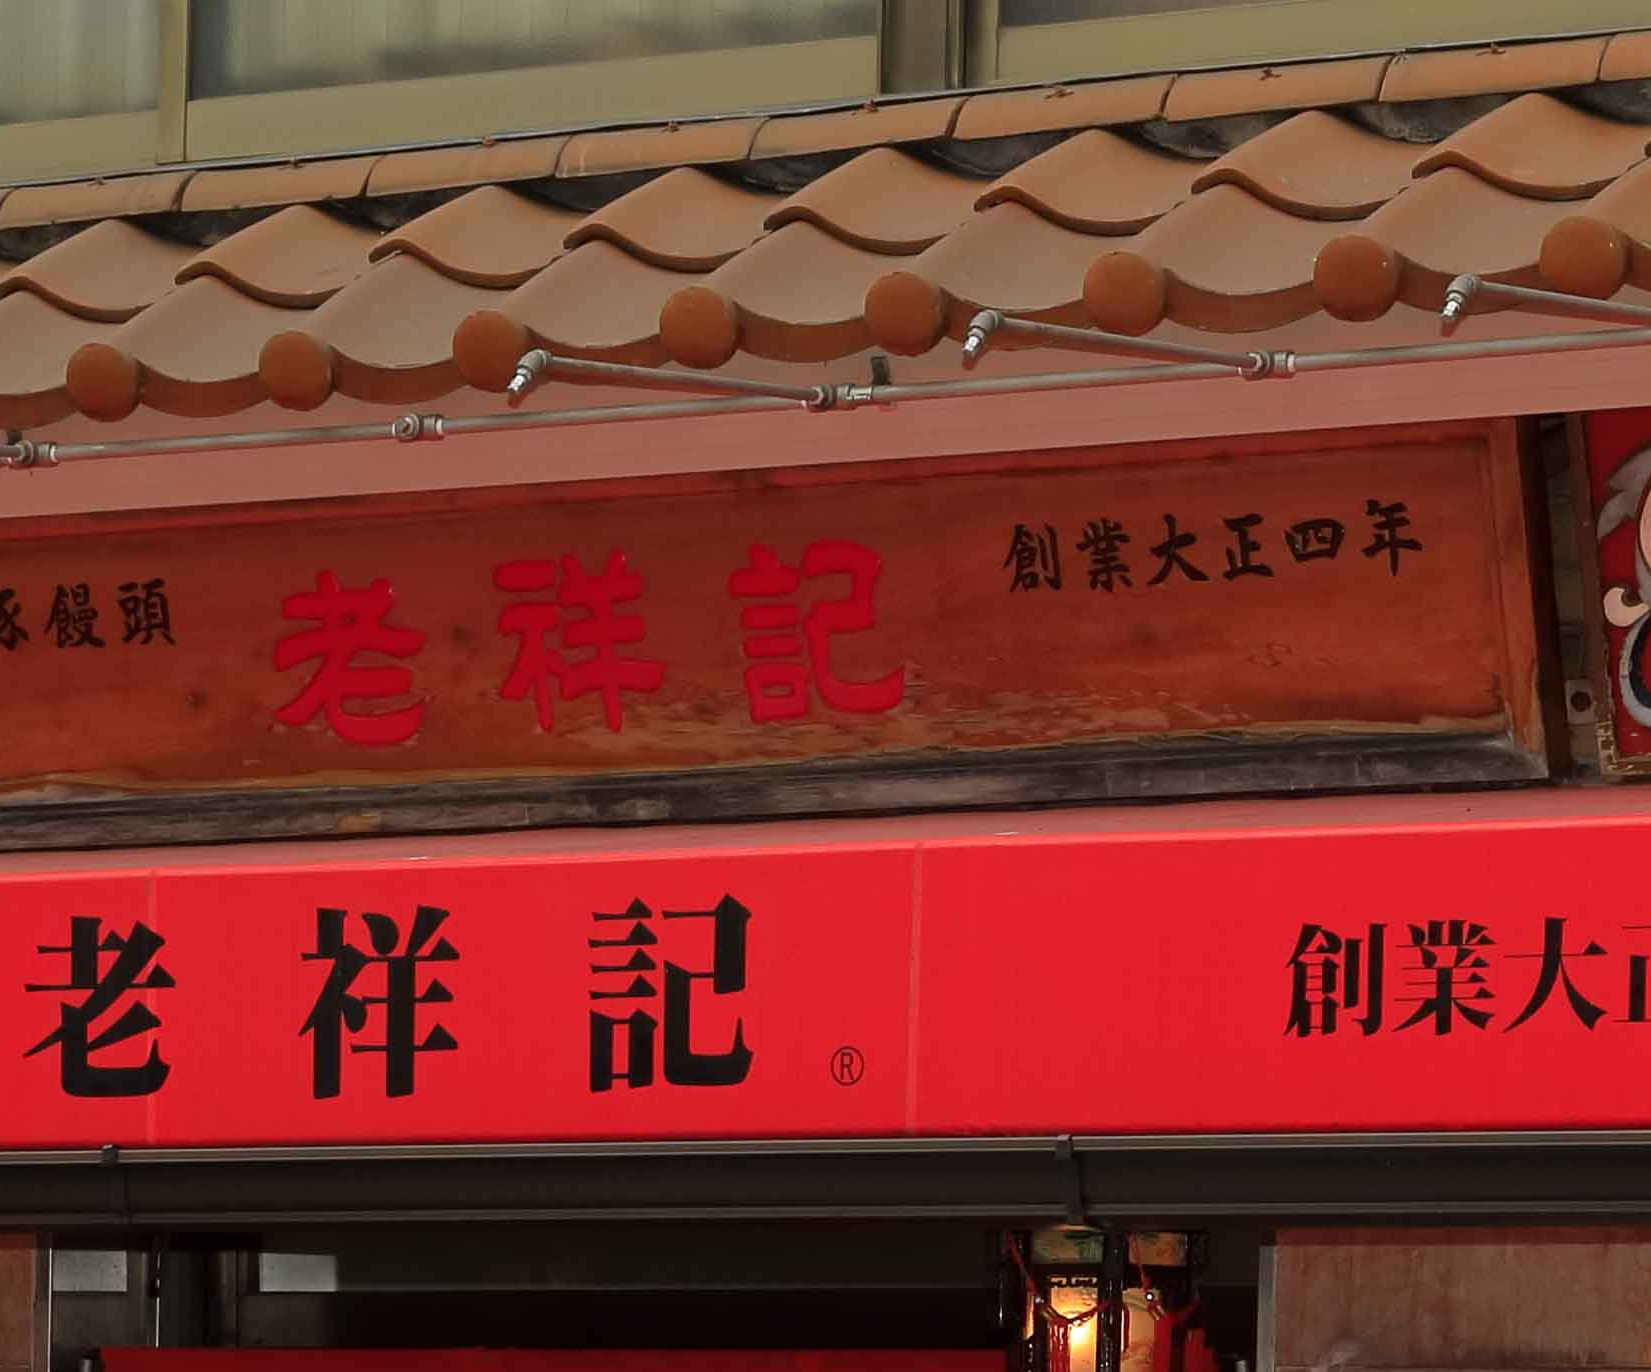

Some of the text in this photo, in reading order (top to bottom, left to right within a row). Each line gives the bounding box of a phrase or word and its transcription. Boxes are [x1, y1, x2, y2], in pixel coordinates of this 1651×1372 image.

[271, 538, 906, 748] 老祥記
[1003, 498, 1425, 593] 創業大正四年
[23, 893, 756, 1103] 老祥記
